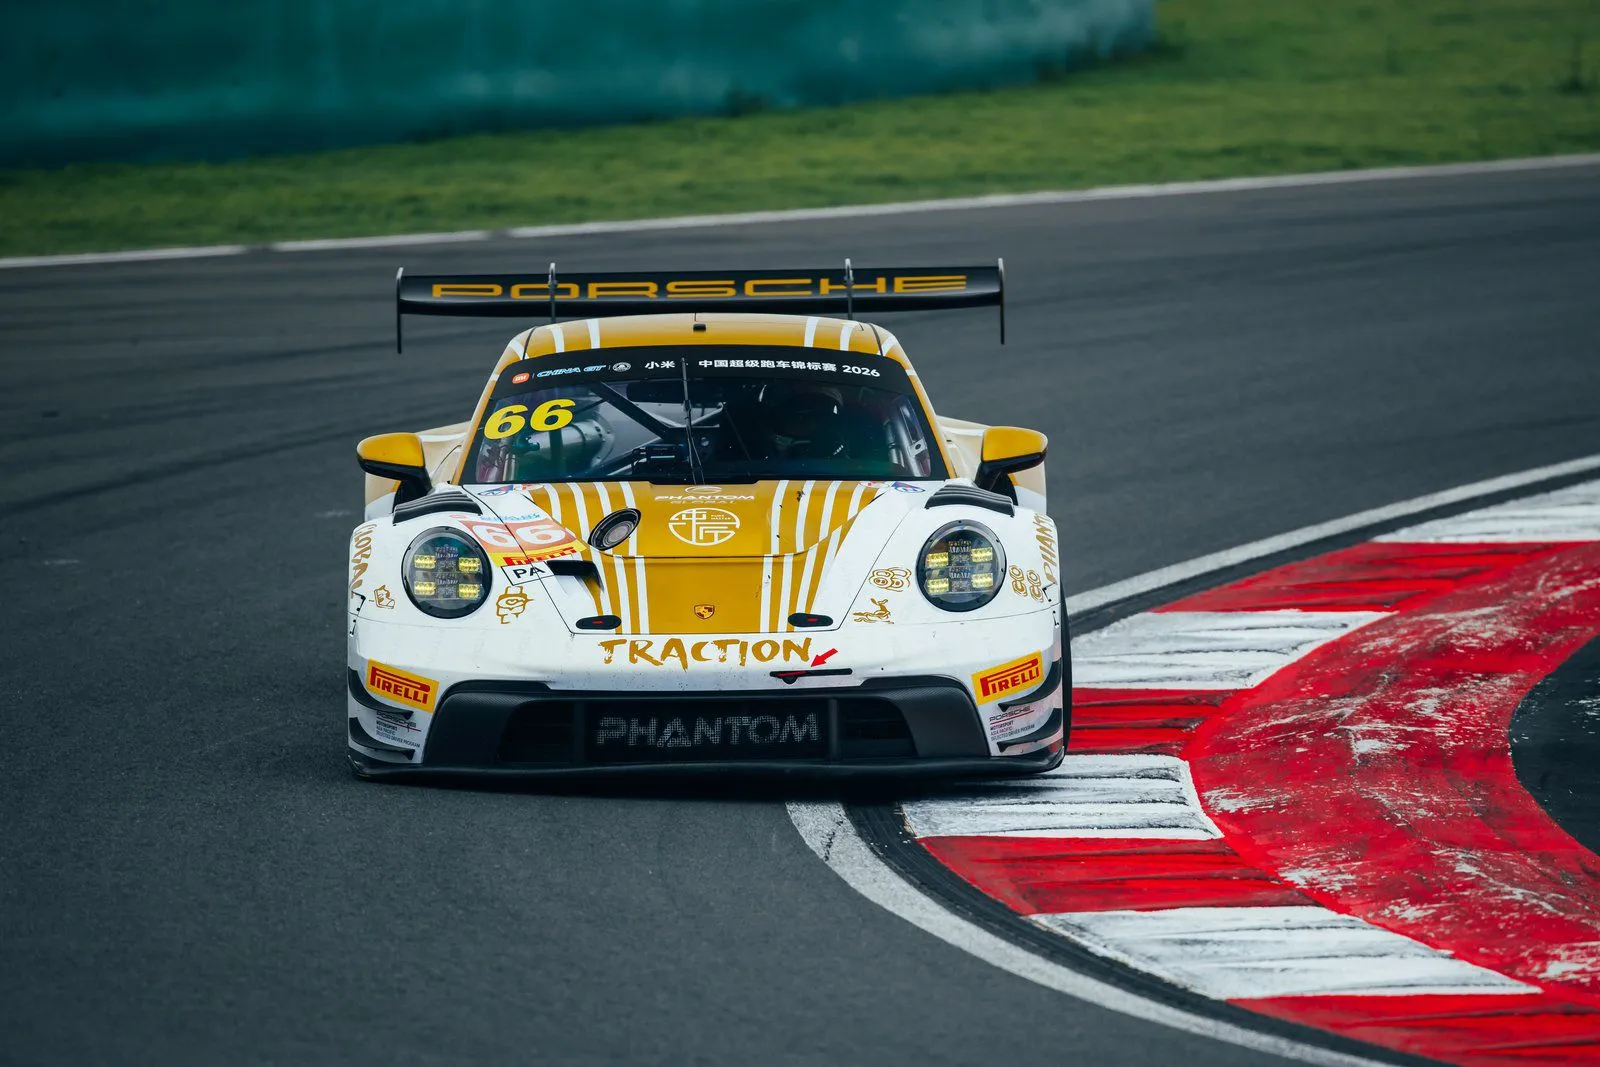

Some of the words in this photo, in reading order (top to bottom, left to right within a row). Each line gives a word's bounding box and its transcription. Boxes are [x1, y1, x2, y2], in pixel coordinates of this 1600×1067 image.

[431, 275, 967, 299] PORSCHE
[645, 361, 676, 370] 小米
[842, 365, 880, 377] 2026
[484, 399, 576, 440] 66
[472, 524, 566, 548] 66
[513, 567, 545, 578] PA
[598, 637, 812, 671] TRACTION
[370, 666, 431, 704] PIRELLI
[979, 658, 1040, 697] PIRELLI
[989, 706, 1030, 721] PORSCHE
[596, 713, 818, 747] PHANTOM
